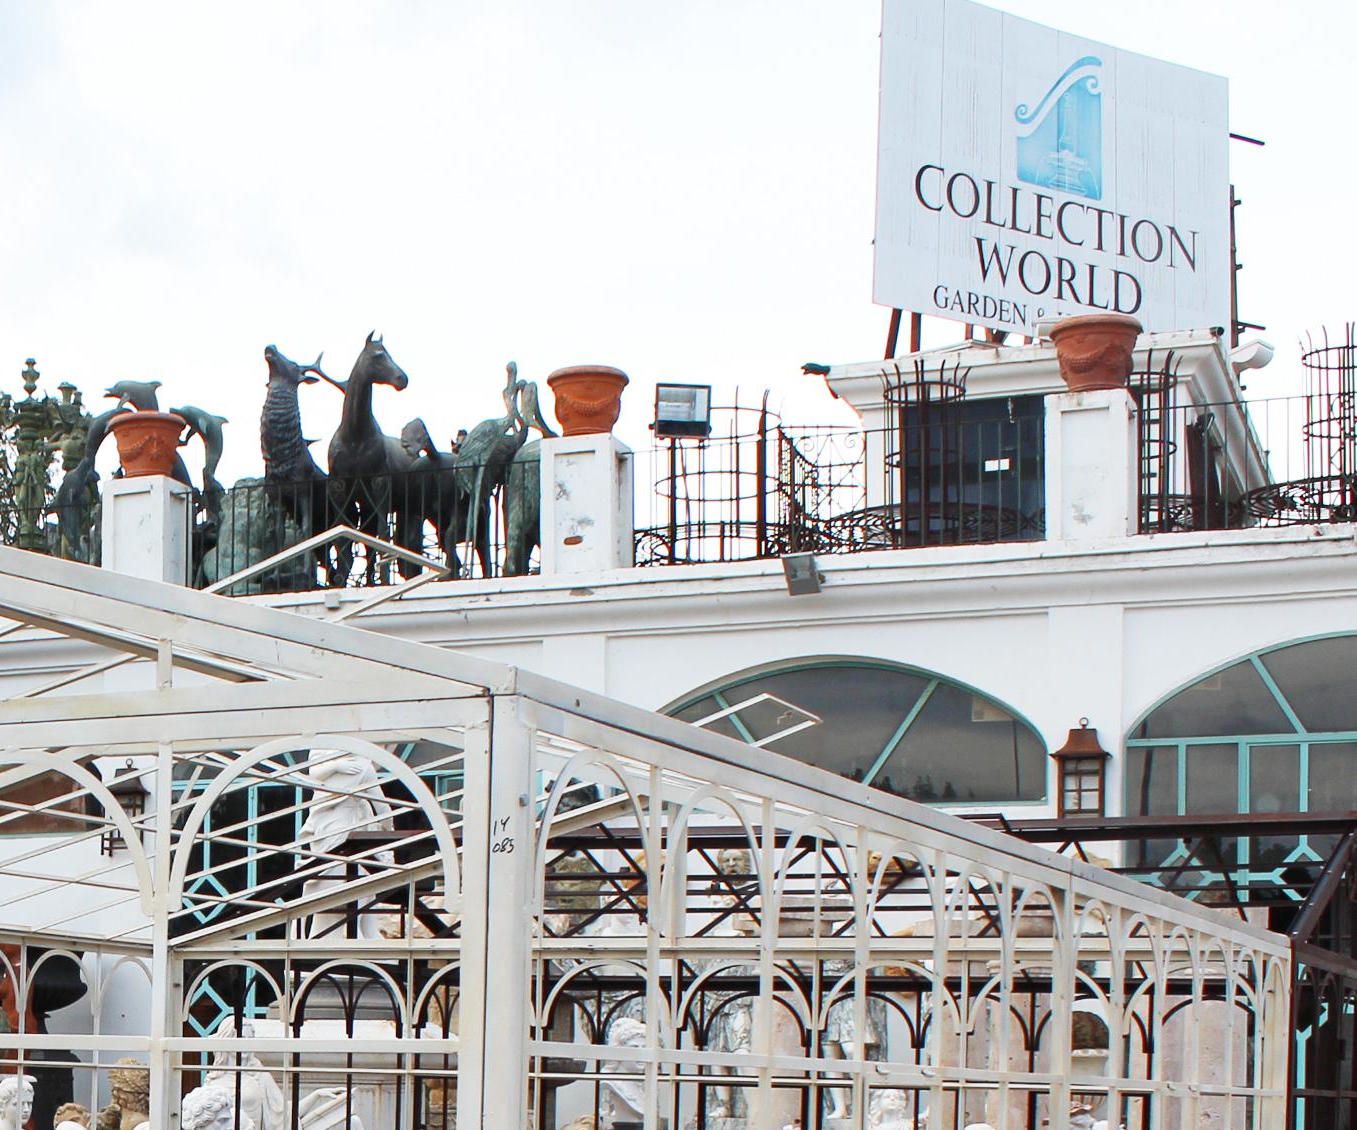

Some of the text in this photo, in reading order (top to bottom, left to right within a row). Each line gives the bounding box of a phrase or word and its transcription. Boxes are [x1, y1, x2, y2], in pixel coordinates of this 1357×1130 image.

[914, 164, 1199, 273] COLLECTION
[933, 285, 1027, 327] GARDEN
[974, 236, 1142, 315] WORLD
